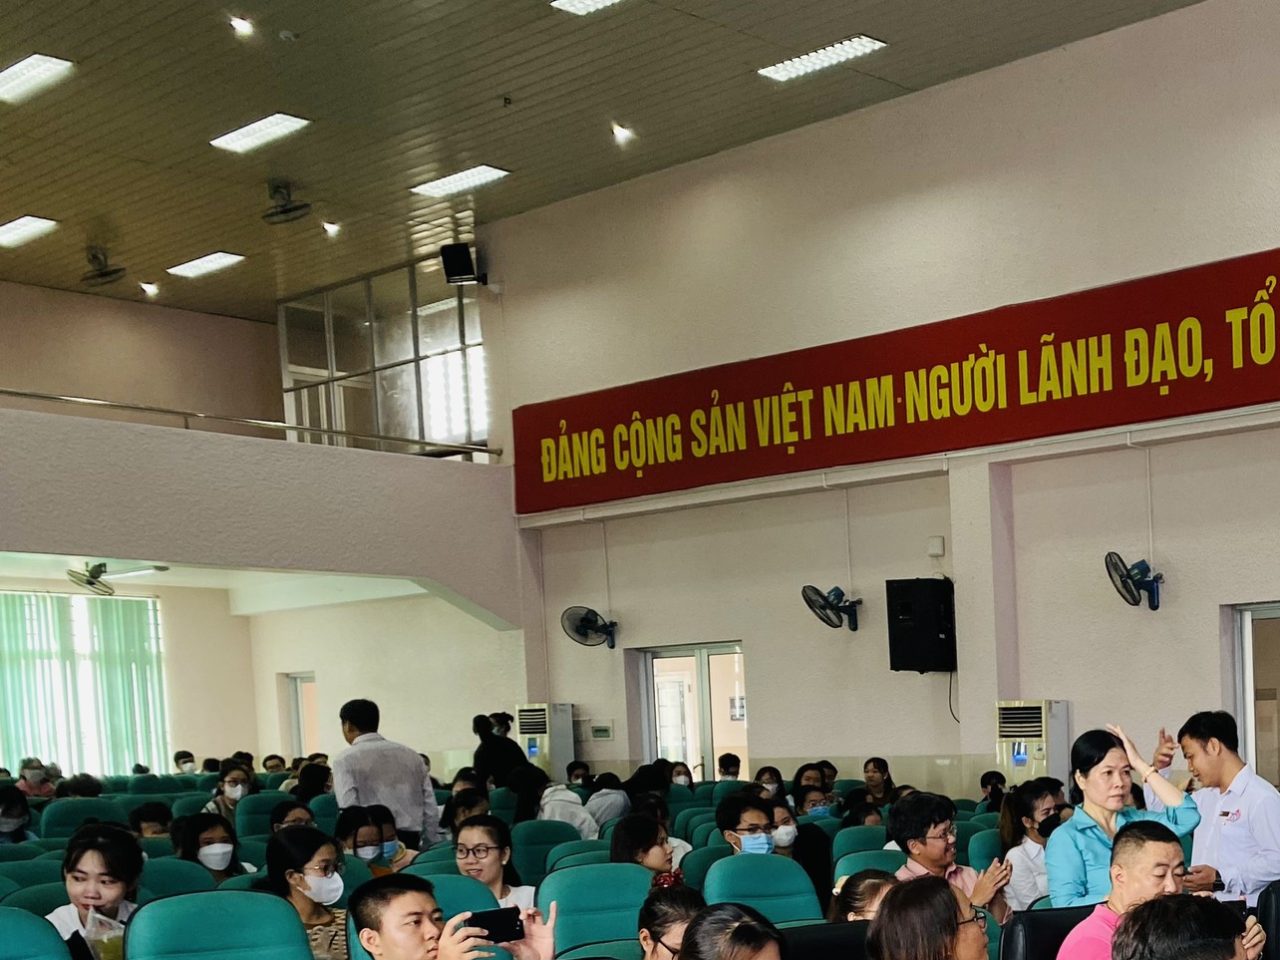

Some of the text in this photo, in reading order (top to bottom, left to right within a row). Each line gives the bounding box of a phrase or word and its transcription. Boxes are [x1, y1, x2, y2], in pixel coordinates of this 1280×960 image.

[541, 419, 607, 481] ĐẢNG
[613, 411, 683, 478] CỘNG
[690, 389, 747, 458] SẢN
[754, 382, 813, 454] VIỆT
[823, 375, 895, 436] NAM
[905, 342, 1007, 424] NGƯỜI
[1018, 333, 1113, 405] LÃNH
[1124, 317, 1213, 396] ĐẠO,
[1225, 275, 1277, 368] TỔ
